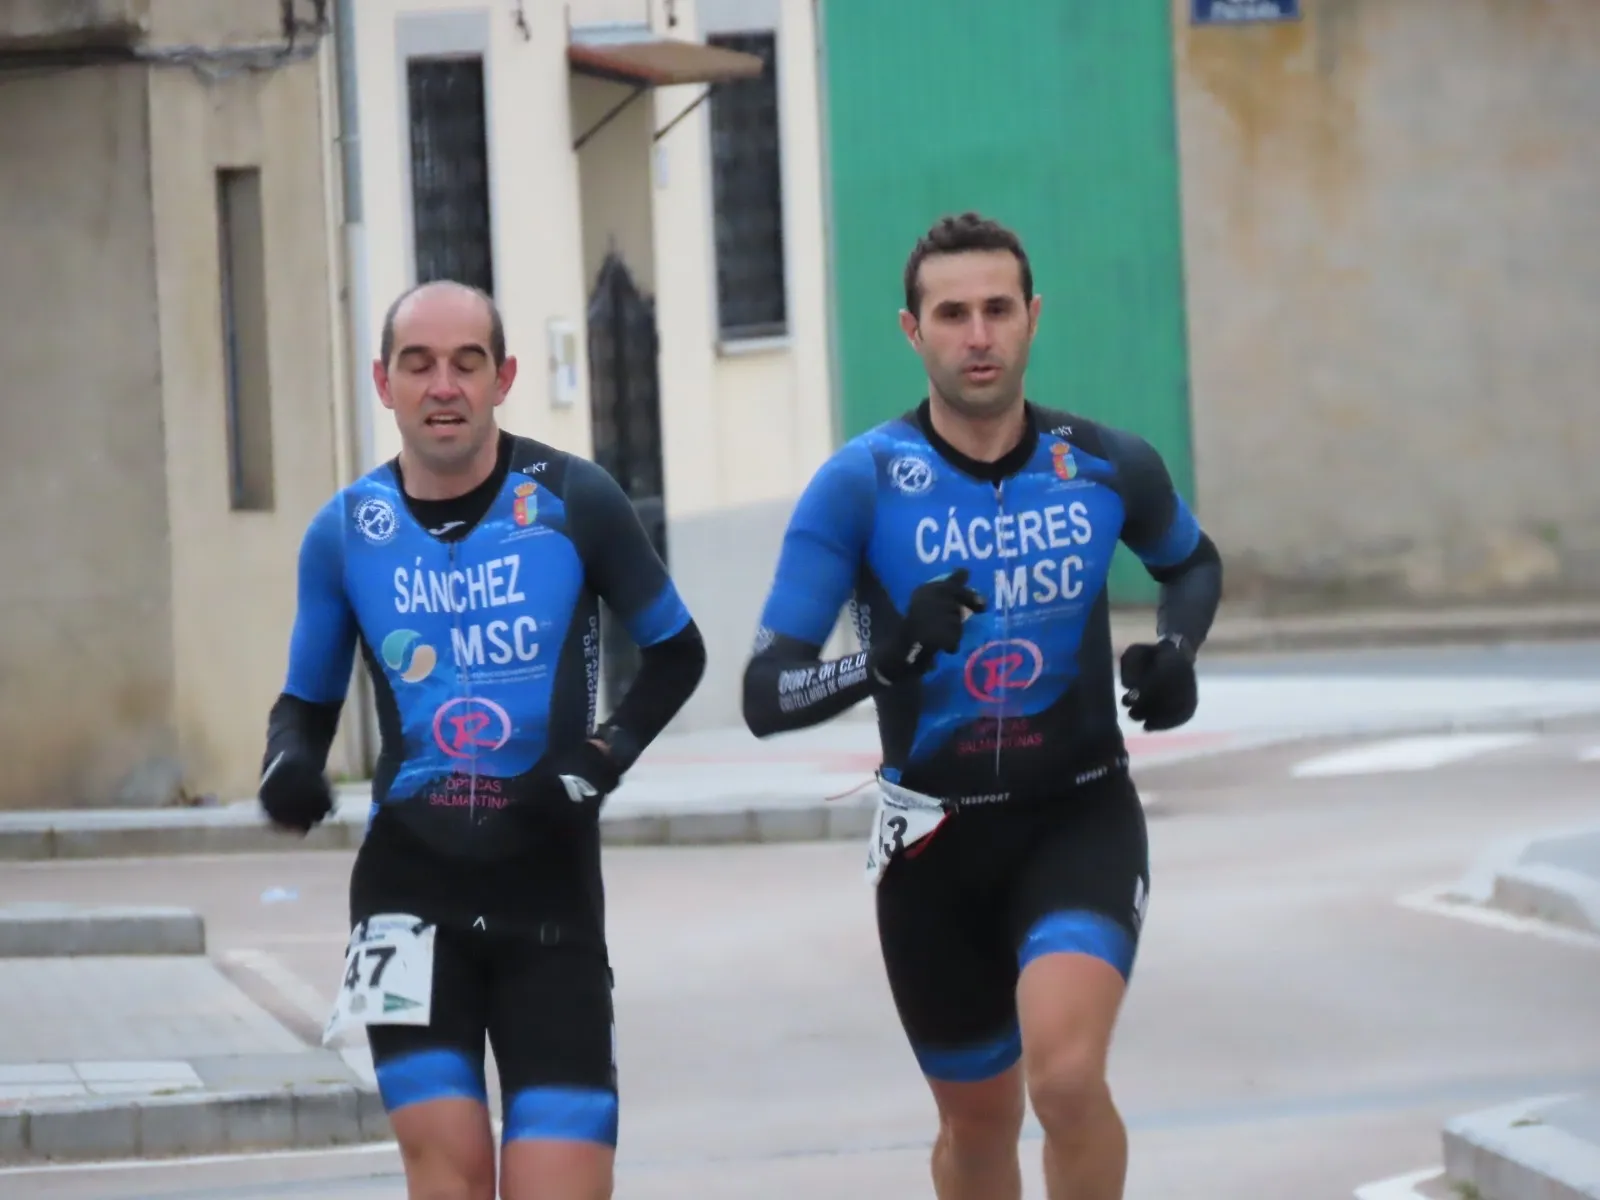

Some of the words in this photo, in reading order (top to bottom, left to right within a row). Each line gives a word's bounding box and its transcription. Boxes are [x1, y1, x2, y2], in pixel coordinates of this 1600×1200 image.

[915, 501, 1093, 565] CÁCERES
[394, 554, 526, 614] SÁNCHEZ
[994, 554, 1084, 611] MSC
[451, 615, 540, 667] MSC
[445, 777, 502, 793] OPTCAS
[343, 945, 397, 991] 47
